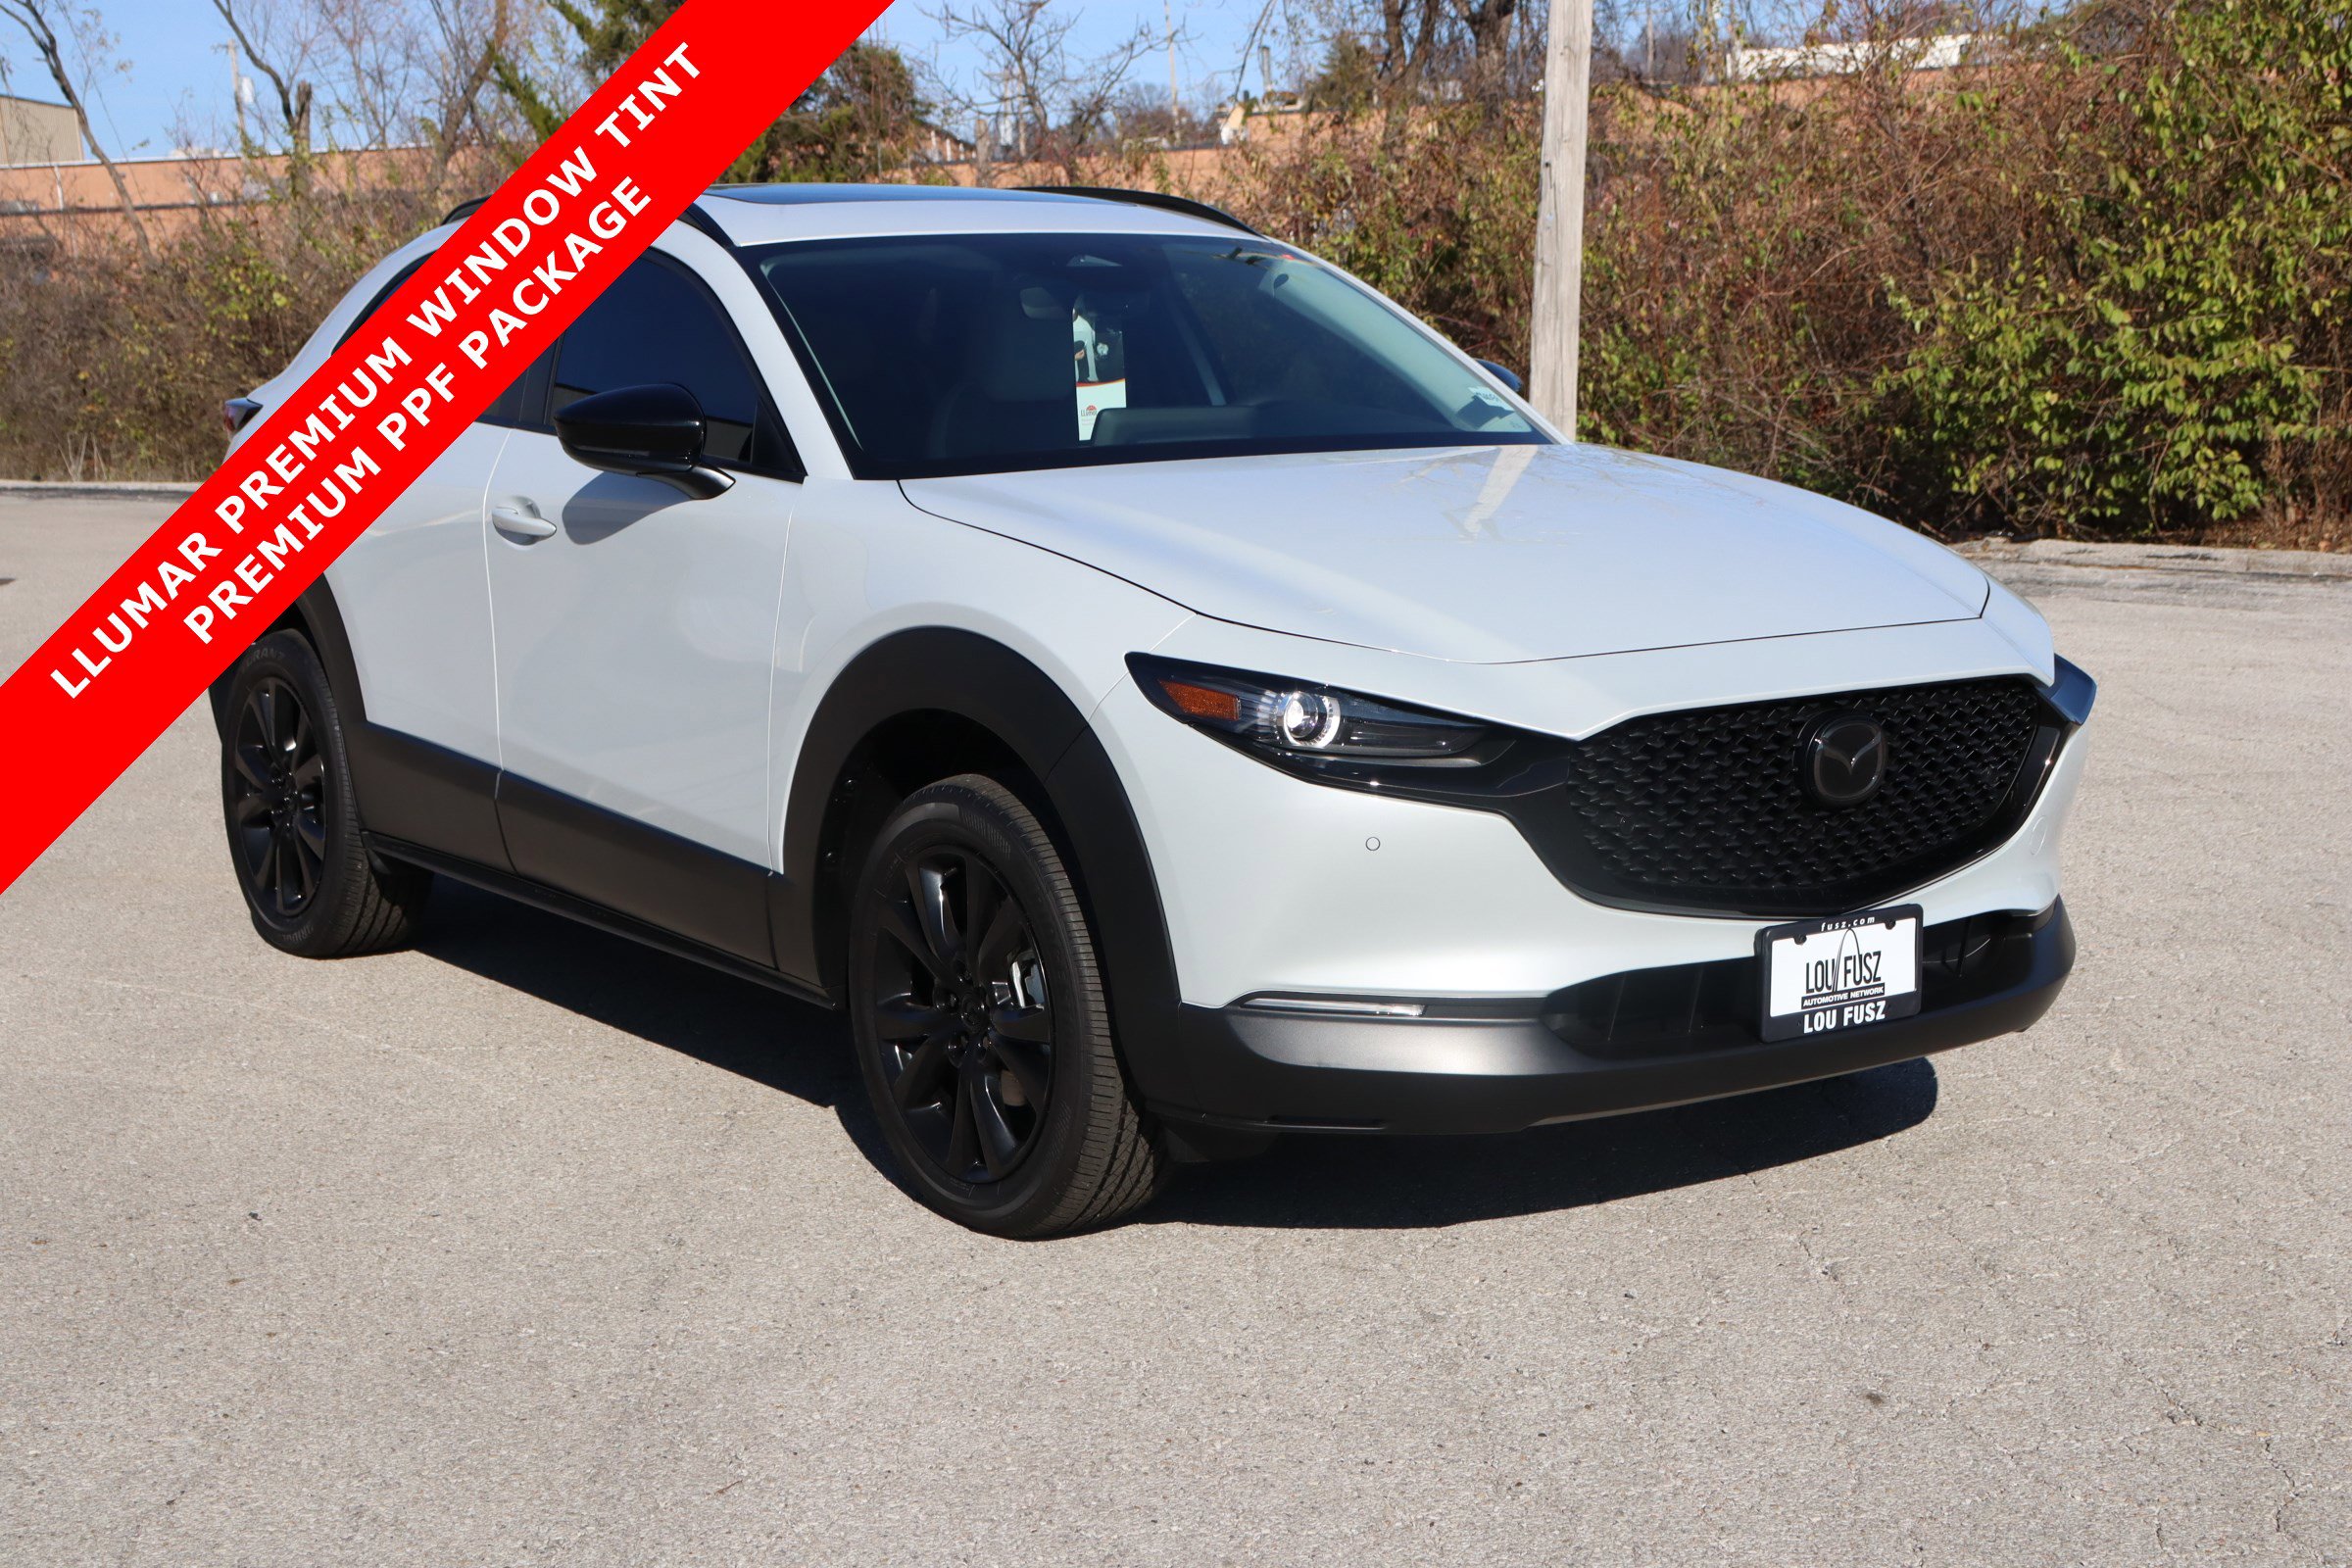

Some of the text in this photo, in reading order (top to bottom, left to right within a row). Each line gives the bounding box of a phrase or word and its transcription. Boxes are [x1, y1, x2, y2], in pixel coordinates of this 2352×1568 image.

[1821, 916, 1876, 932] fusz.com
[1805, 951, 1882, 994] LOU FUSZ
[1802, 986, 1884, 1006] AUTOMOTIVE NETWORK
[1803, 1001, 1886, 1034] LOU FUSZ
